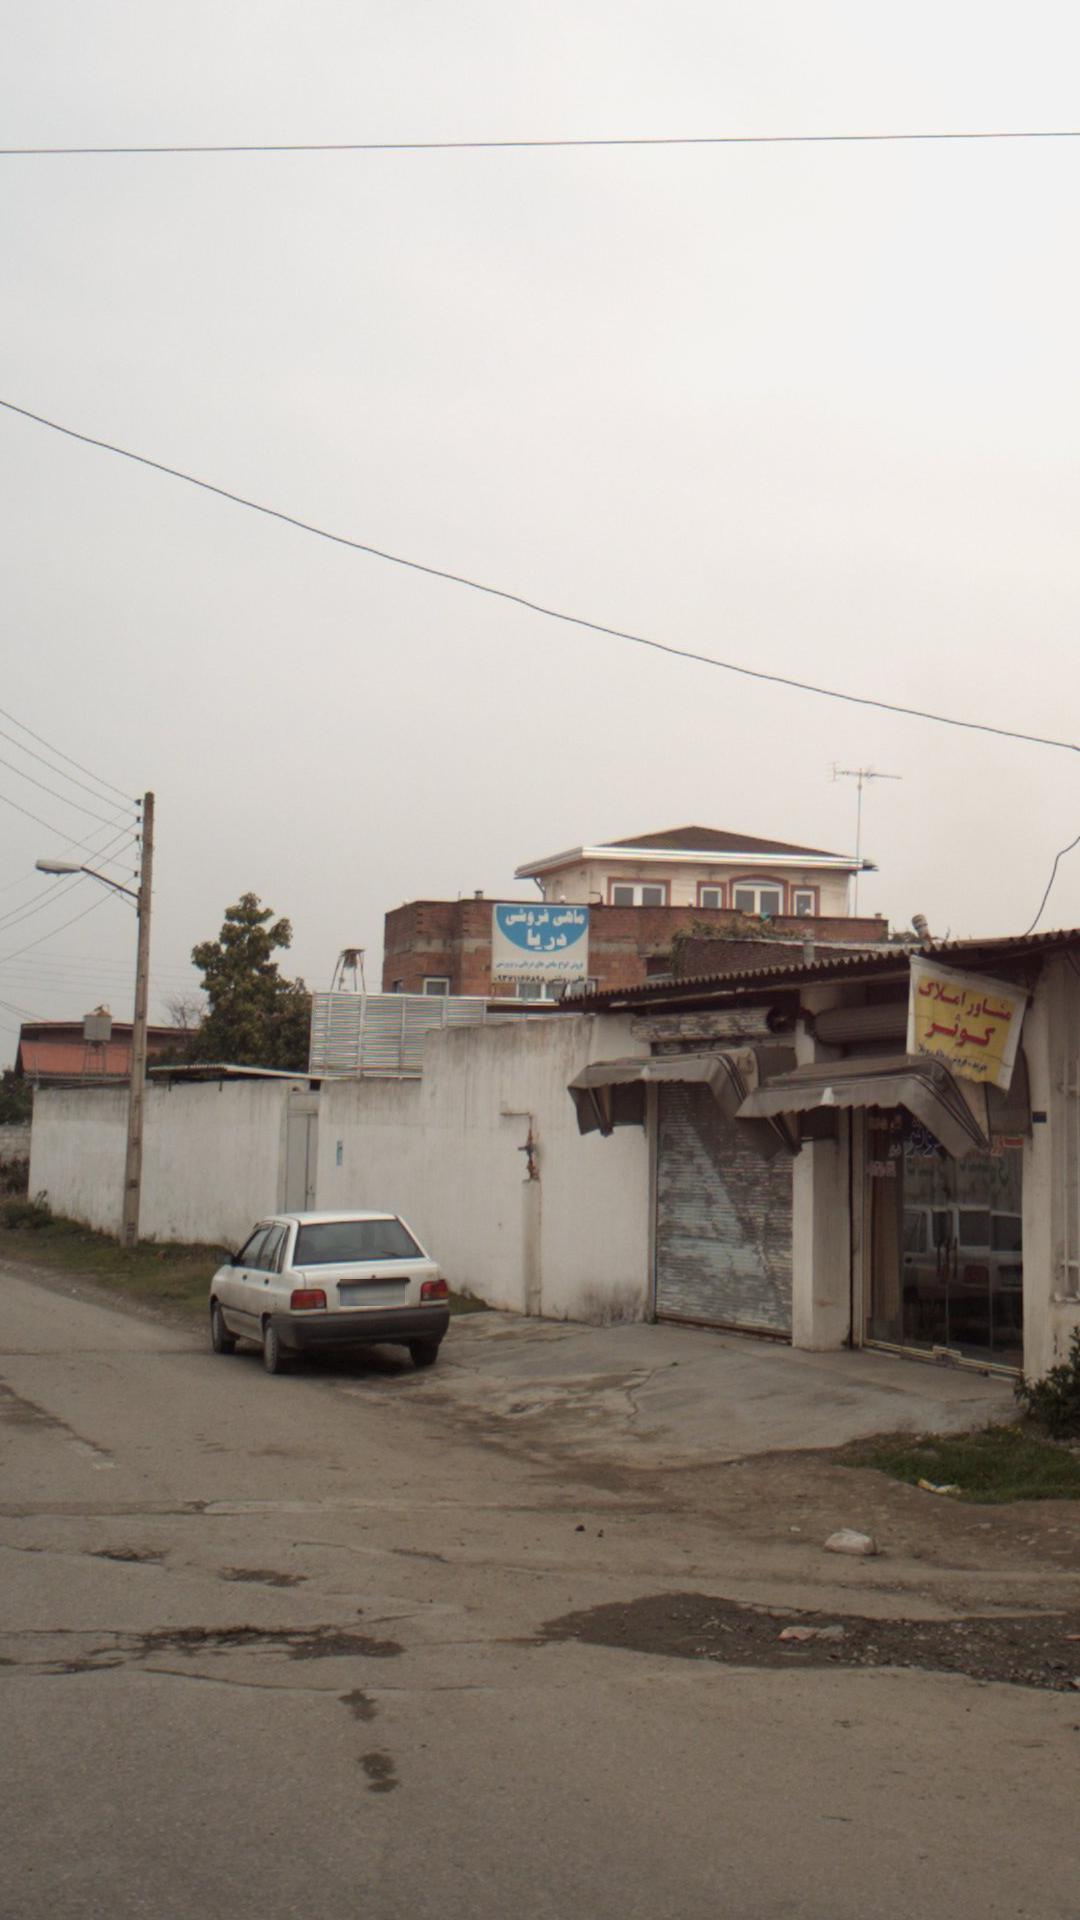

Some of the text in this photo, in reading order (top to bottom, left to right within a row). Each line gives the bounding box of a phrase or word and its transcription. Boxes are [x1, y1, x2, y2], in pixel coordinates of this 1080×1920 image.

[505, 908, 549, 926] فروشی
[527, 928, 567, 950] دریا
[918, 982, 1012, 1021] مشاور املاک
[924, 1014, 996, 1048] کوثر
